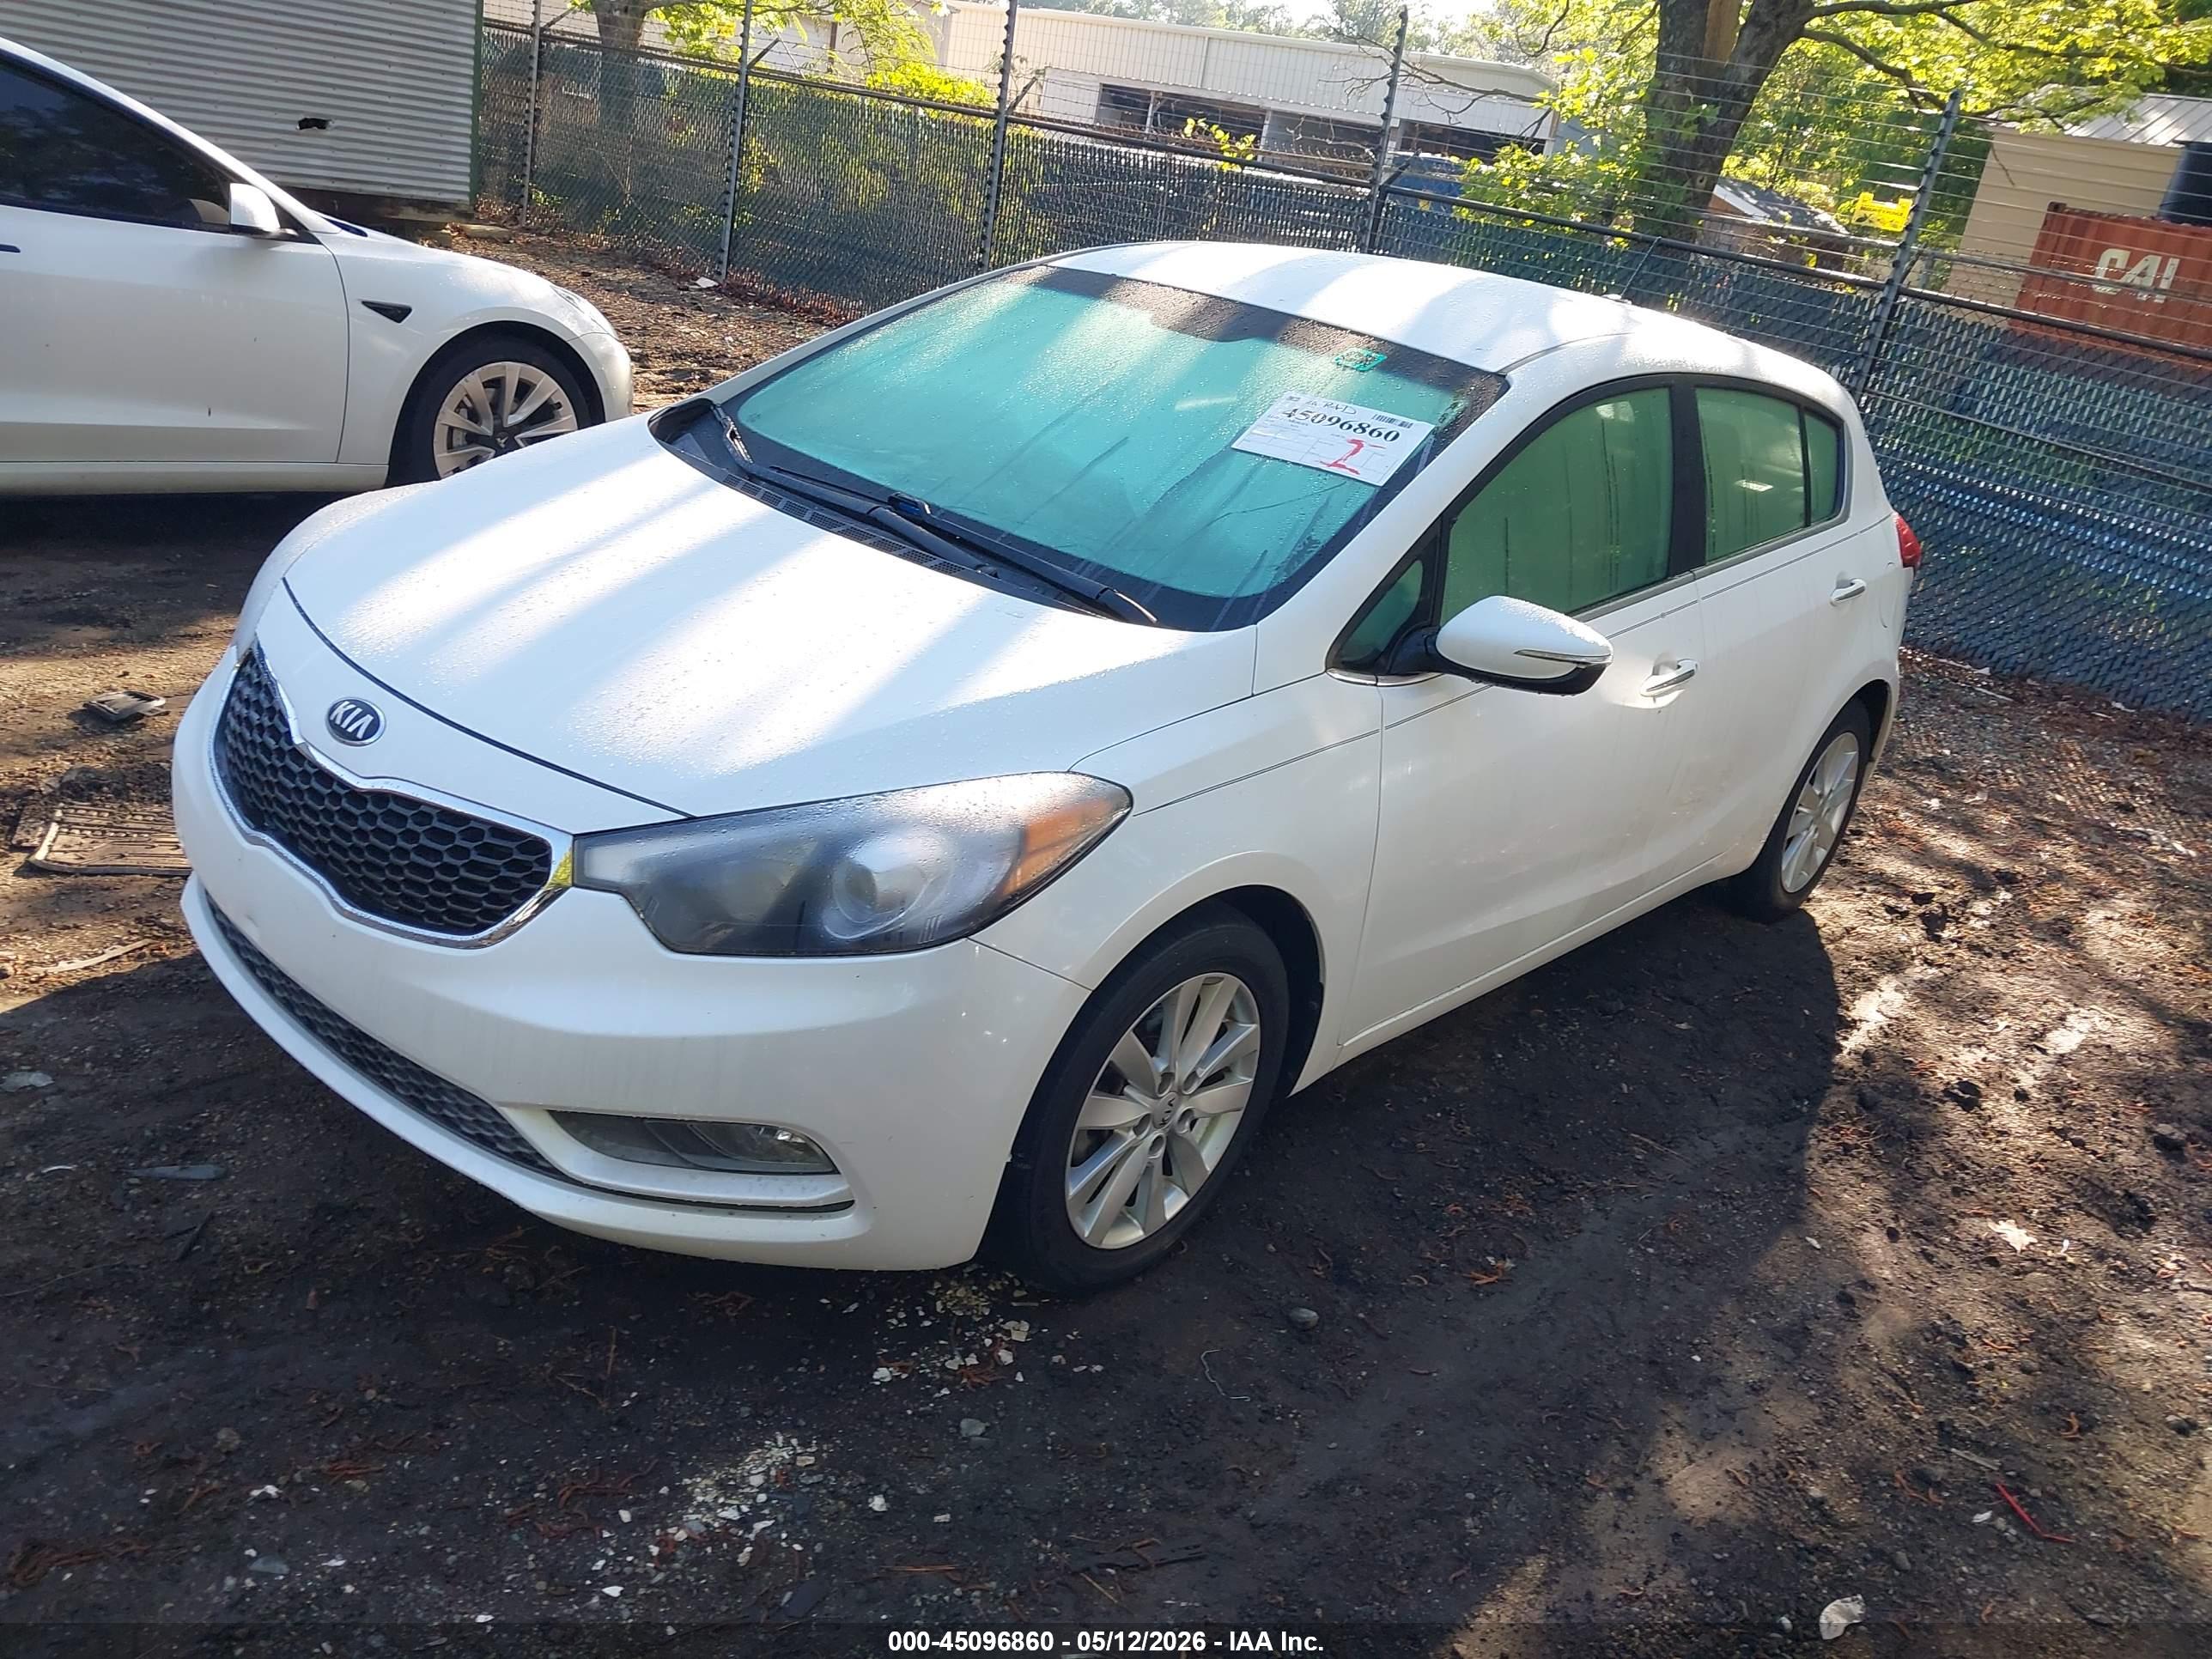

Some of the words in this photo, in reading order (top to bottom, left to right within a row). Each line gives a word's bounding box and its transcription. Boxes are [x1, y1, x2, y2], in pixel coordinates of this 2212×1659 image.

[2092, 248, 2181, 304] CAI
[1282, 408, 1401, 442] 45096860
[329, 701, 374, 739] KIA
[1159, 1097, 1176, 1126] KIA
